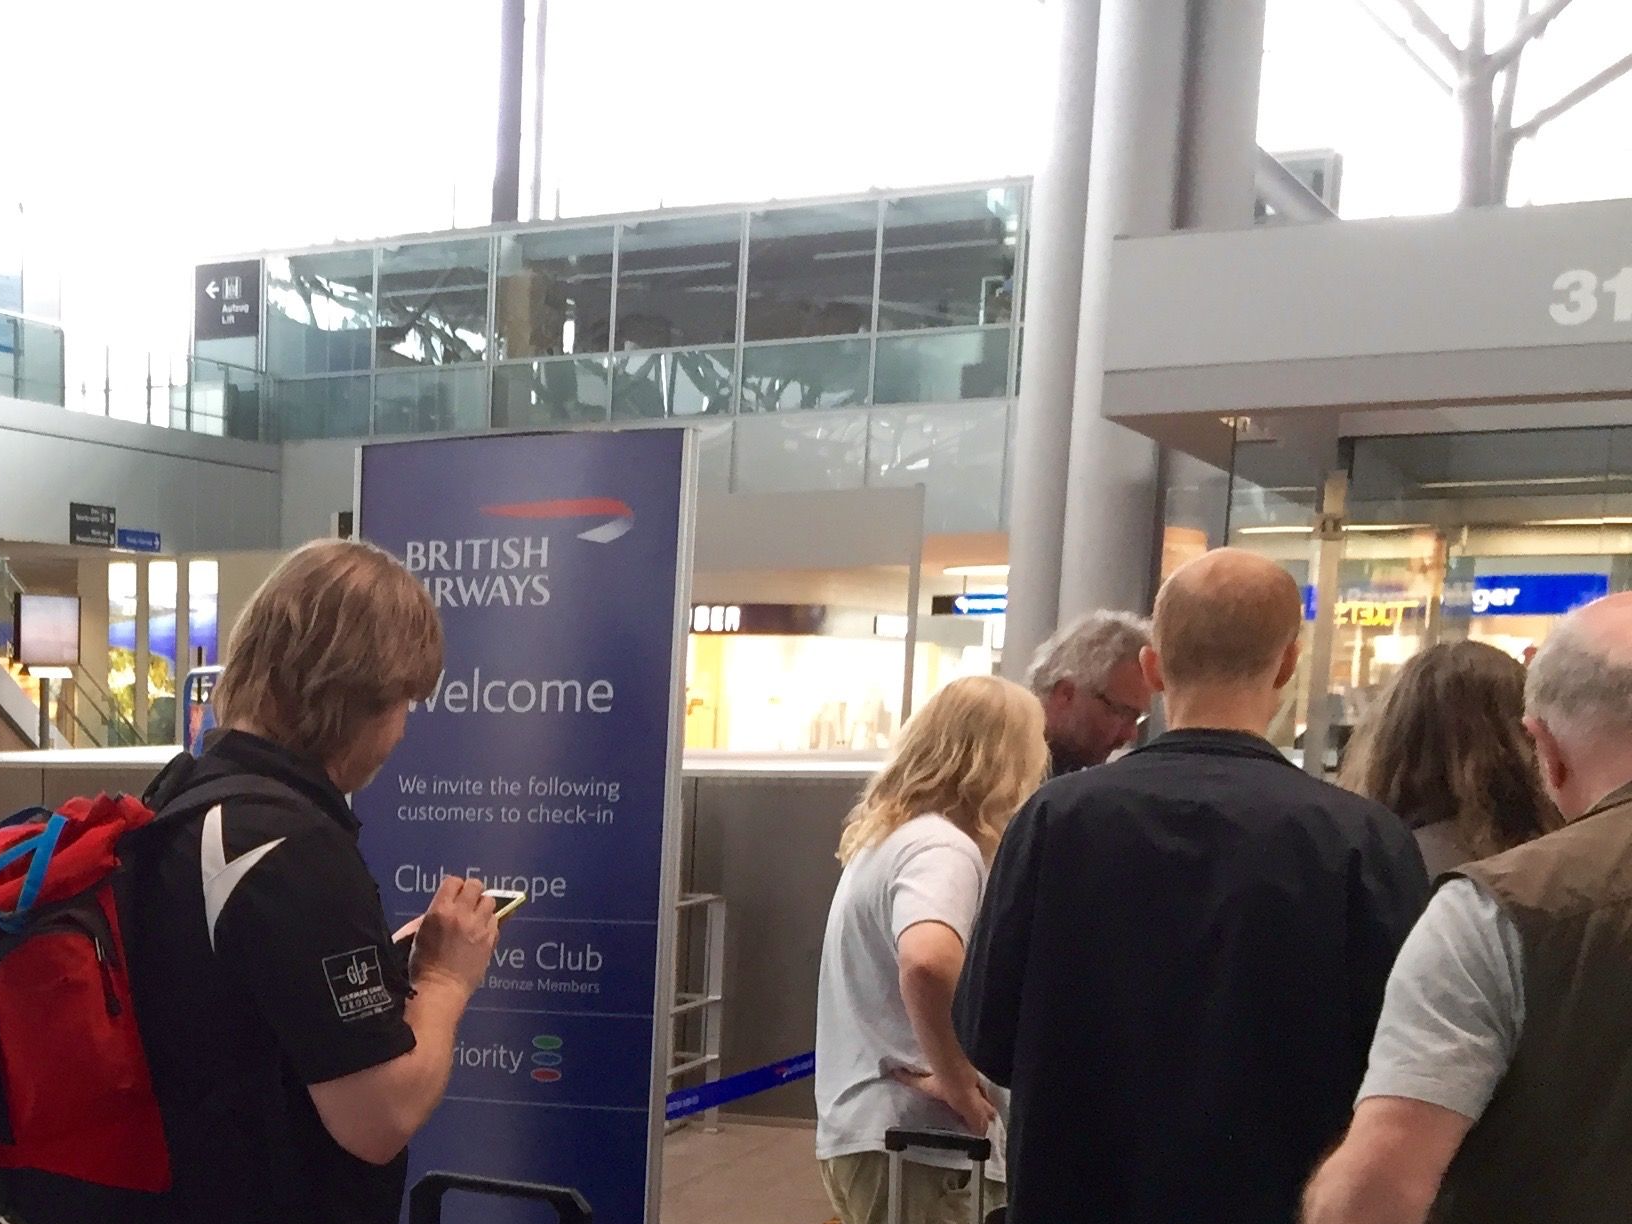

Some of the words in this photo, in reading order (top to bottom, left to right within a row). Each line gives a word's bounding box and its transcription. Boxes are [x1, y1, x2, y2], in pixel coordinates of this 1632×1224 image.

[1549, 267, 1632, 325] 31
[405, 536, 549, 572] BRITISH
[423, 574, 551, 608] IRWAYS
[398, 775, 427, 795] We
[432, 775, 484, 796] invite
[490, 776, 522, 796] the
[528, 776, 621, 802] following
[397, 803, 494, 823] customers
[500, 804, 521, 823] to
[527, 803, 614, 825] check-in
[535, 941, 603, 972] Club
[488, 975, 534, 991] Bronze
[537, 978, 600, 994] Members
[452, 1041, 524, 1074] riority
